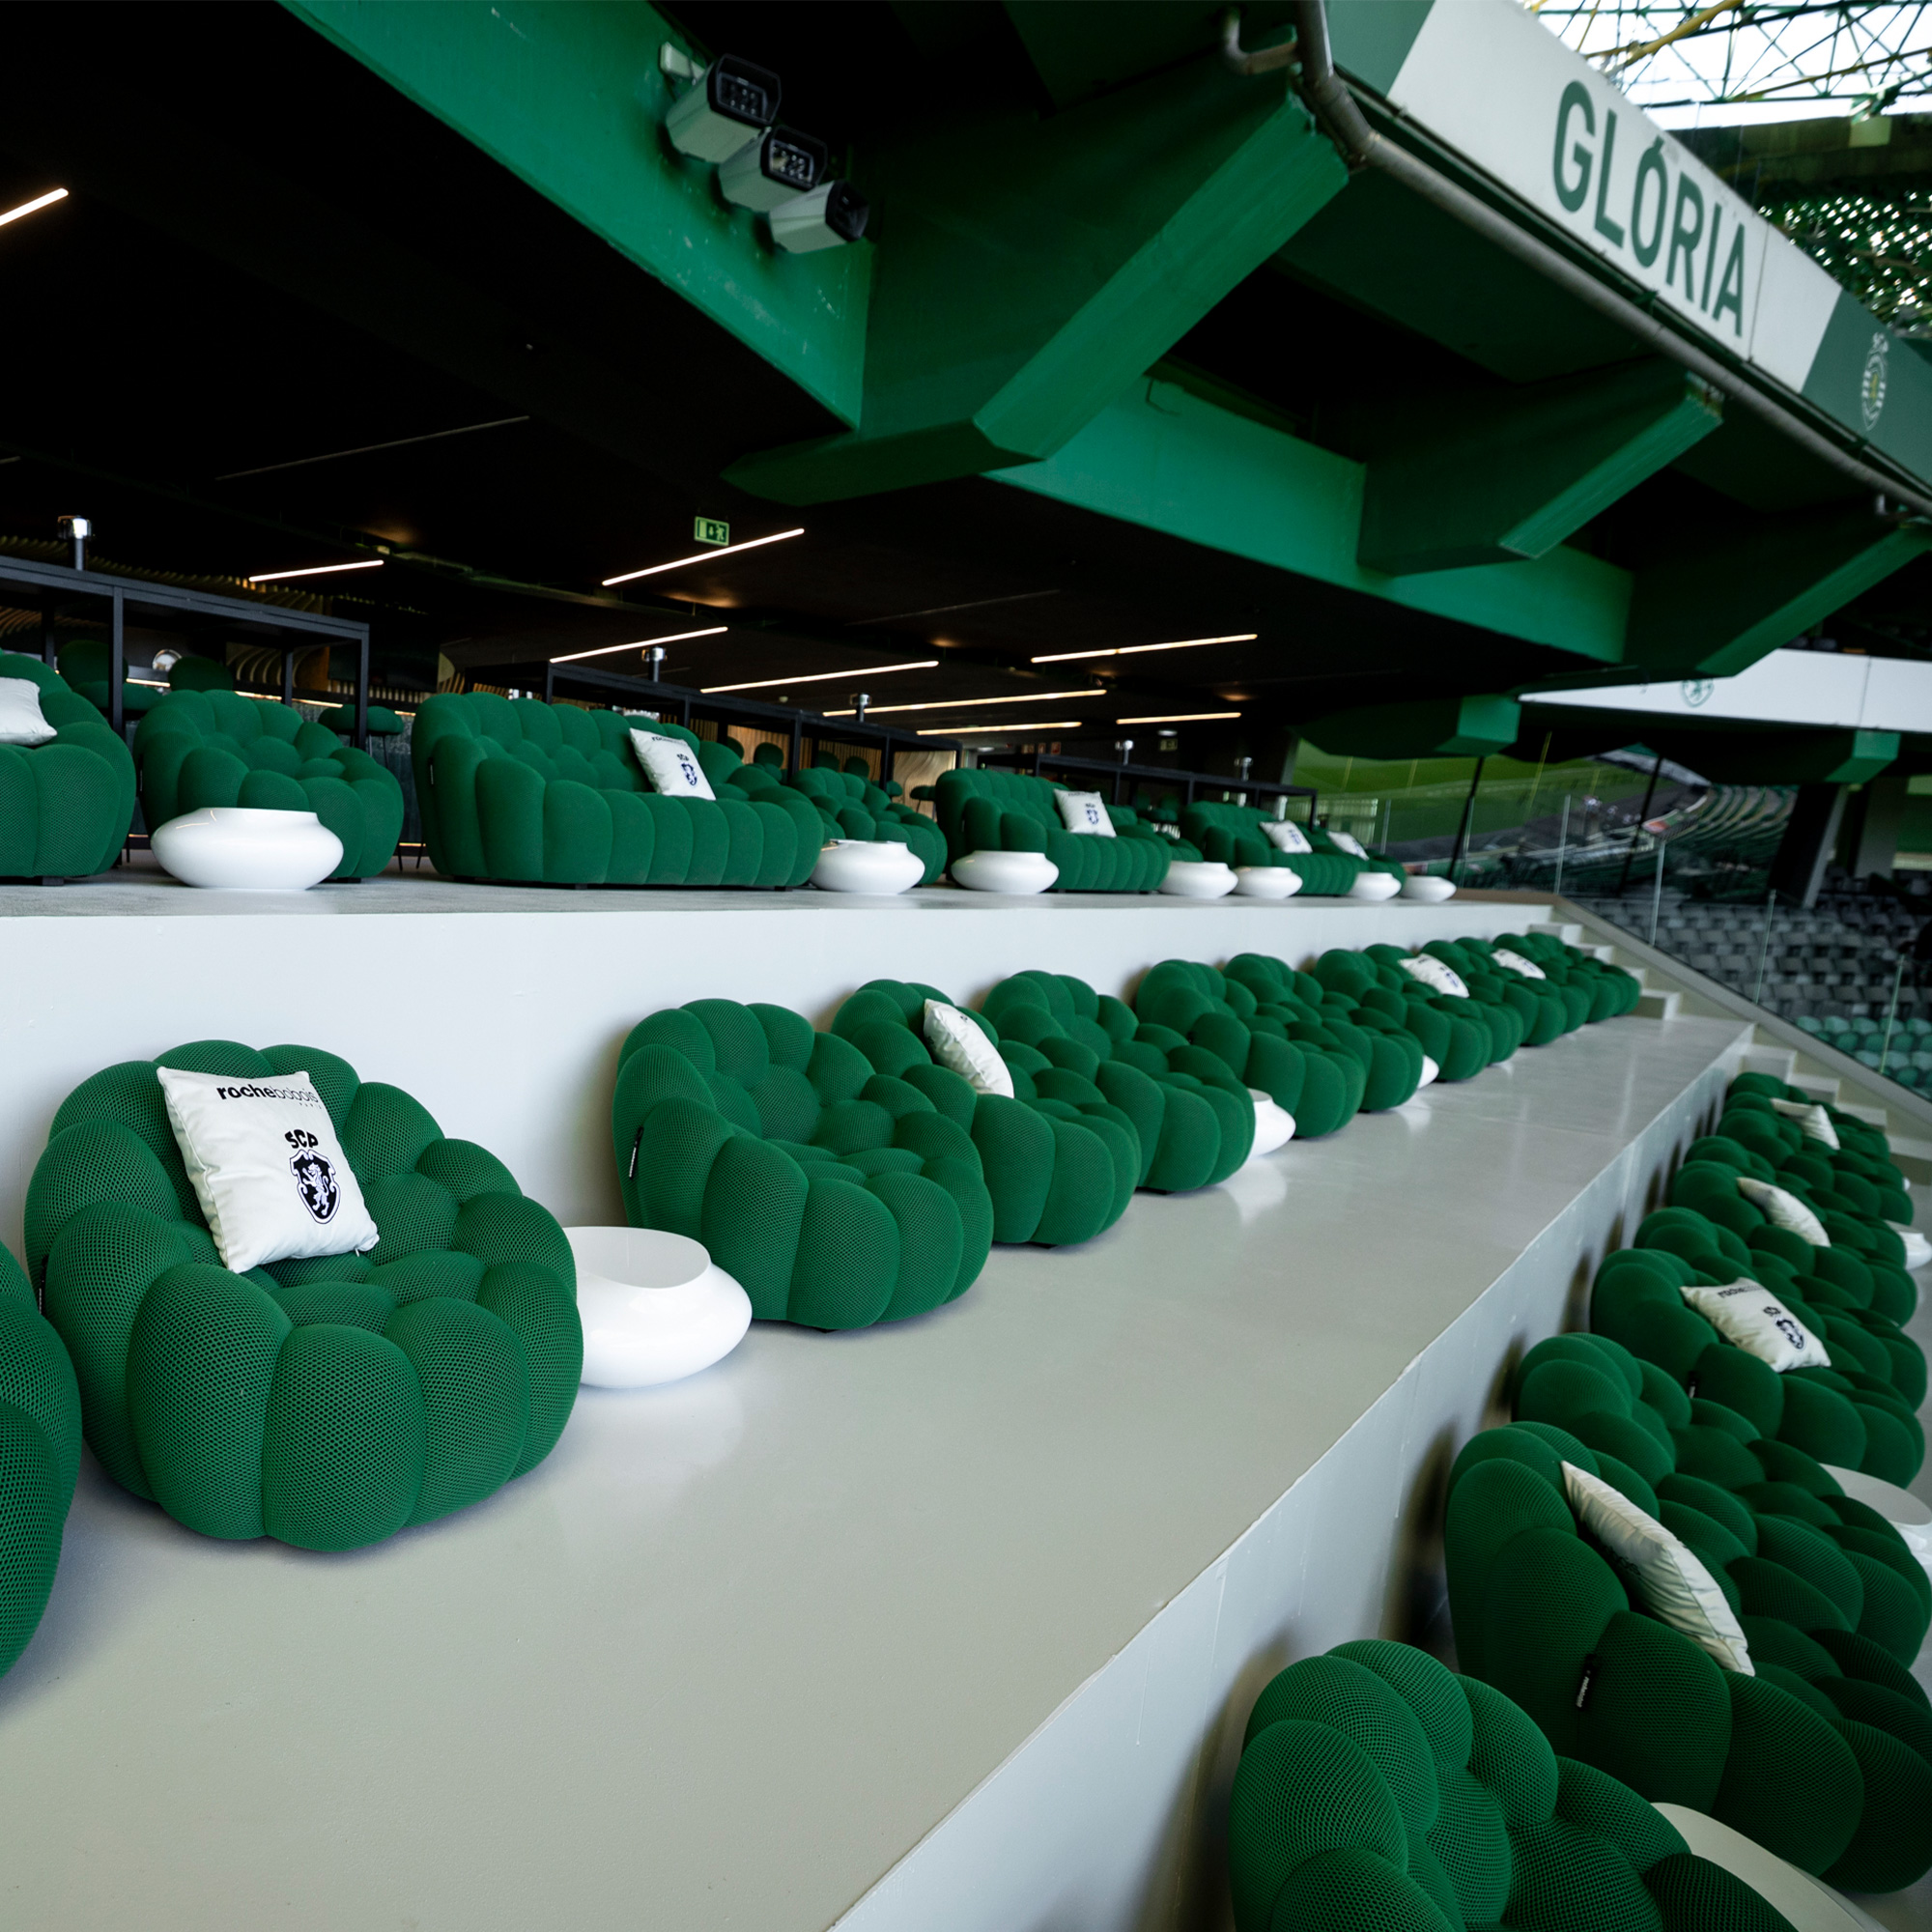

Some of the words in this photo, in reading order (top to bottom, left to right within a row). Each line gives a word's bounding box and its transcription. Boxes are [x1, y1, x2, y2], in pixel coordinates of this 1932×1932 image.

[1553, 79, 1745, 338] GLÓRIA
[216, 1084, 319, 1103] rochebobois
[285, 1129, 319, 1149] SCP
